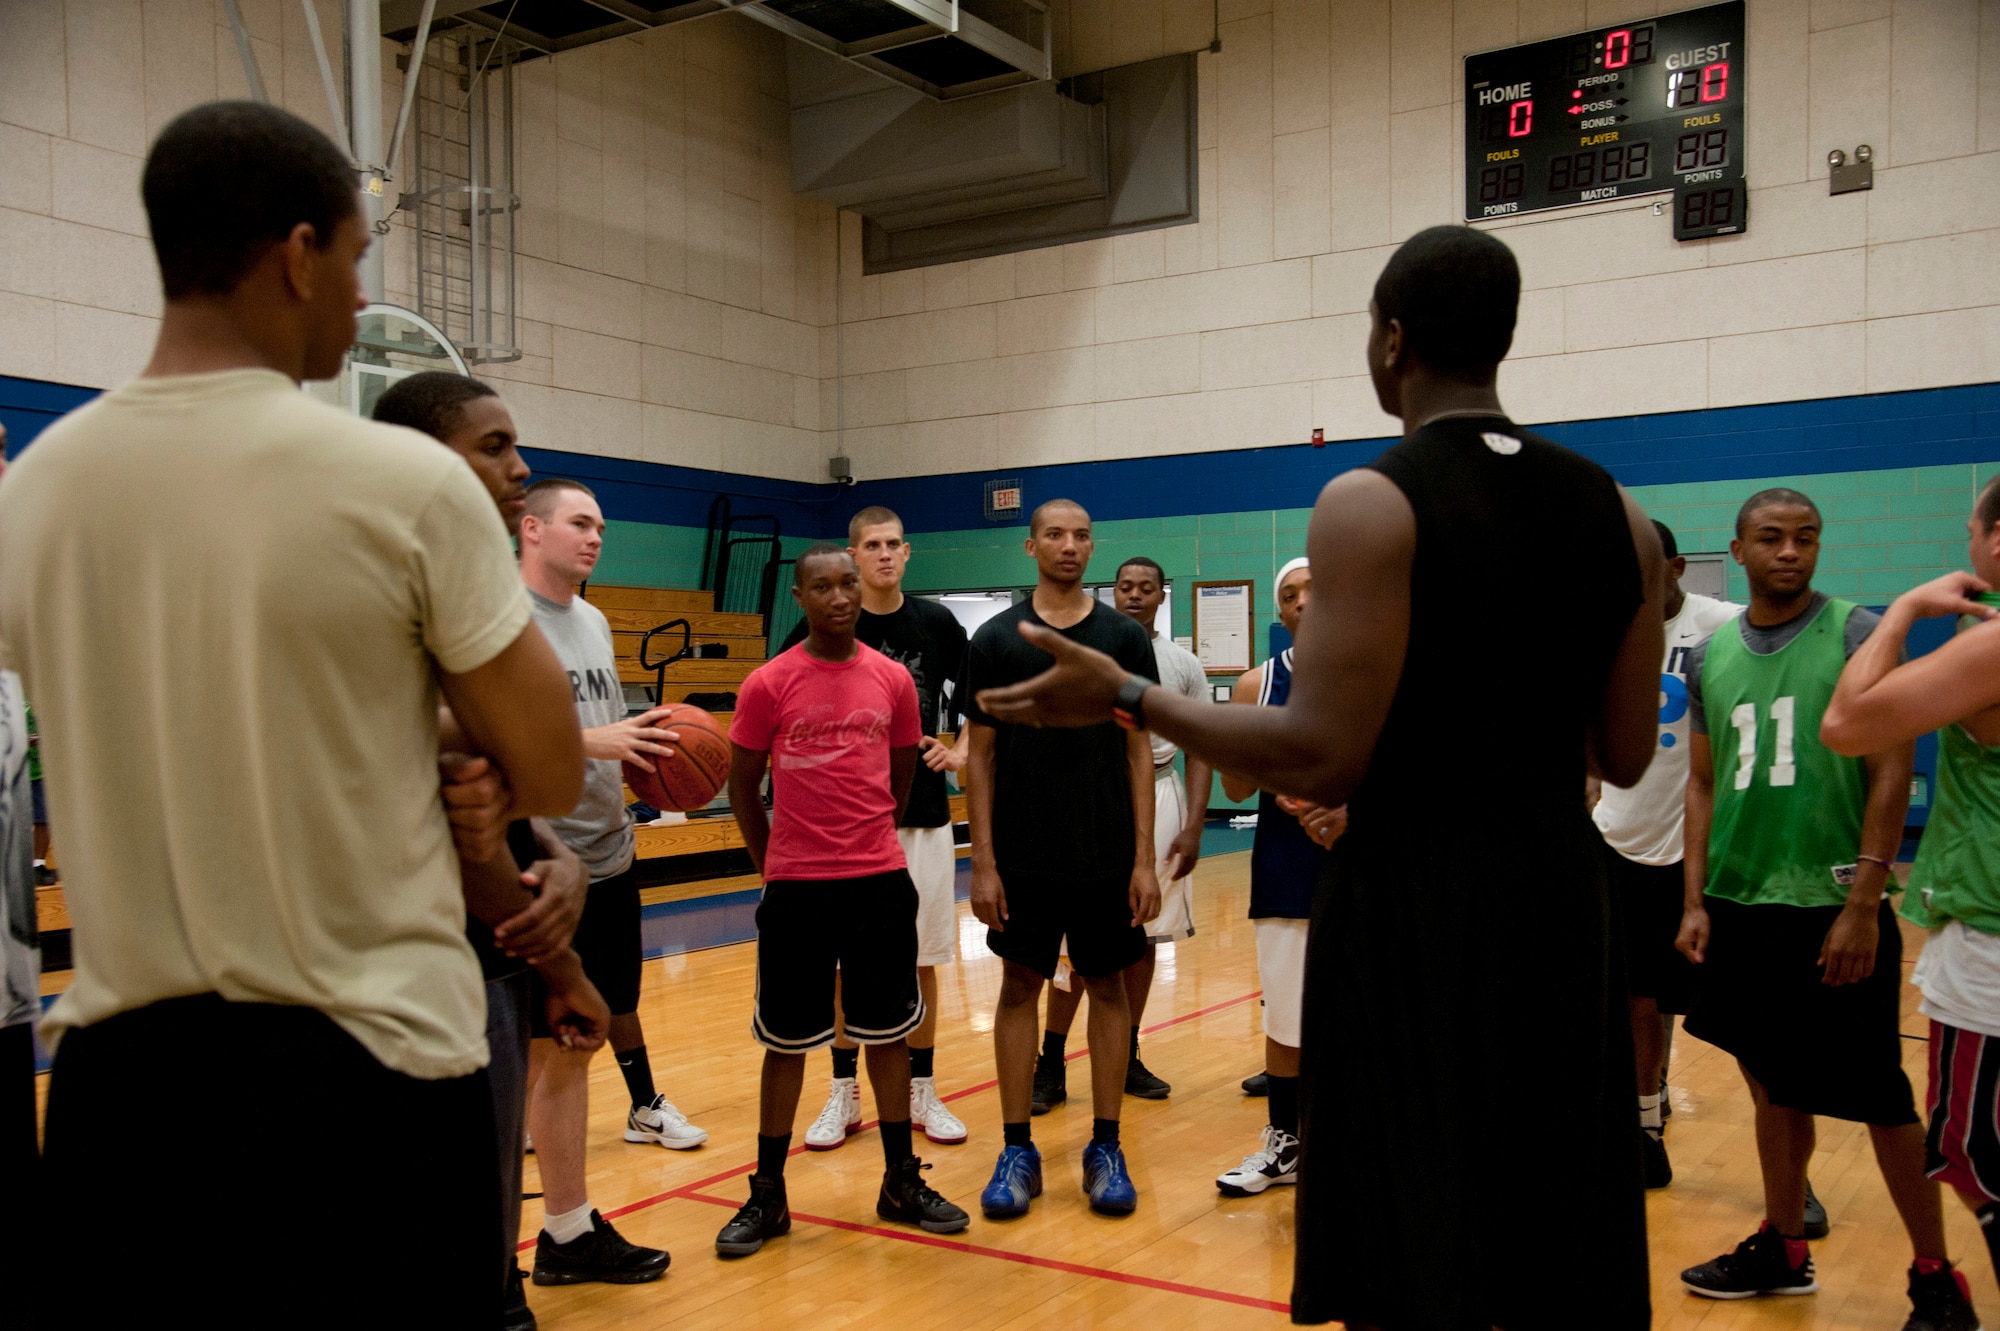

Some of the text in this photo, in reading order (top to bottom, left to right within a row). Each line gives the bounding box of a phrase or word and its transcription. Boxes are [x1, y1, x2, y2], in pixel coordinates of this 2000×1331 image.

[1665, 42, 1731, 70] GUEST
[1578, 73, 1619, 88] PERIOD
[1479, 82, 1532, 105] HOME
[1581, 116, 1616, 130] BONUS
[1684, 113, 1721, 128] FOULS
[1581, 131, 1619, 147] PLAYER
[1487, 149, 1520, 162] FOULS
[1684, 169, 1722, 184] POINTS
[1581, 187, 1617, 201] MATCH
[1484, 202, 1518, 216] POINTS
[998, 490, 1015, 507] EXIT
[567, 668, 620, 702] RMY
[1731, 695, 1796, 790] 11
